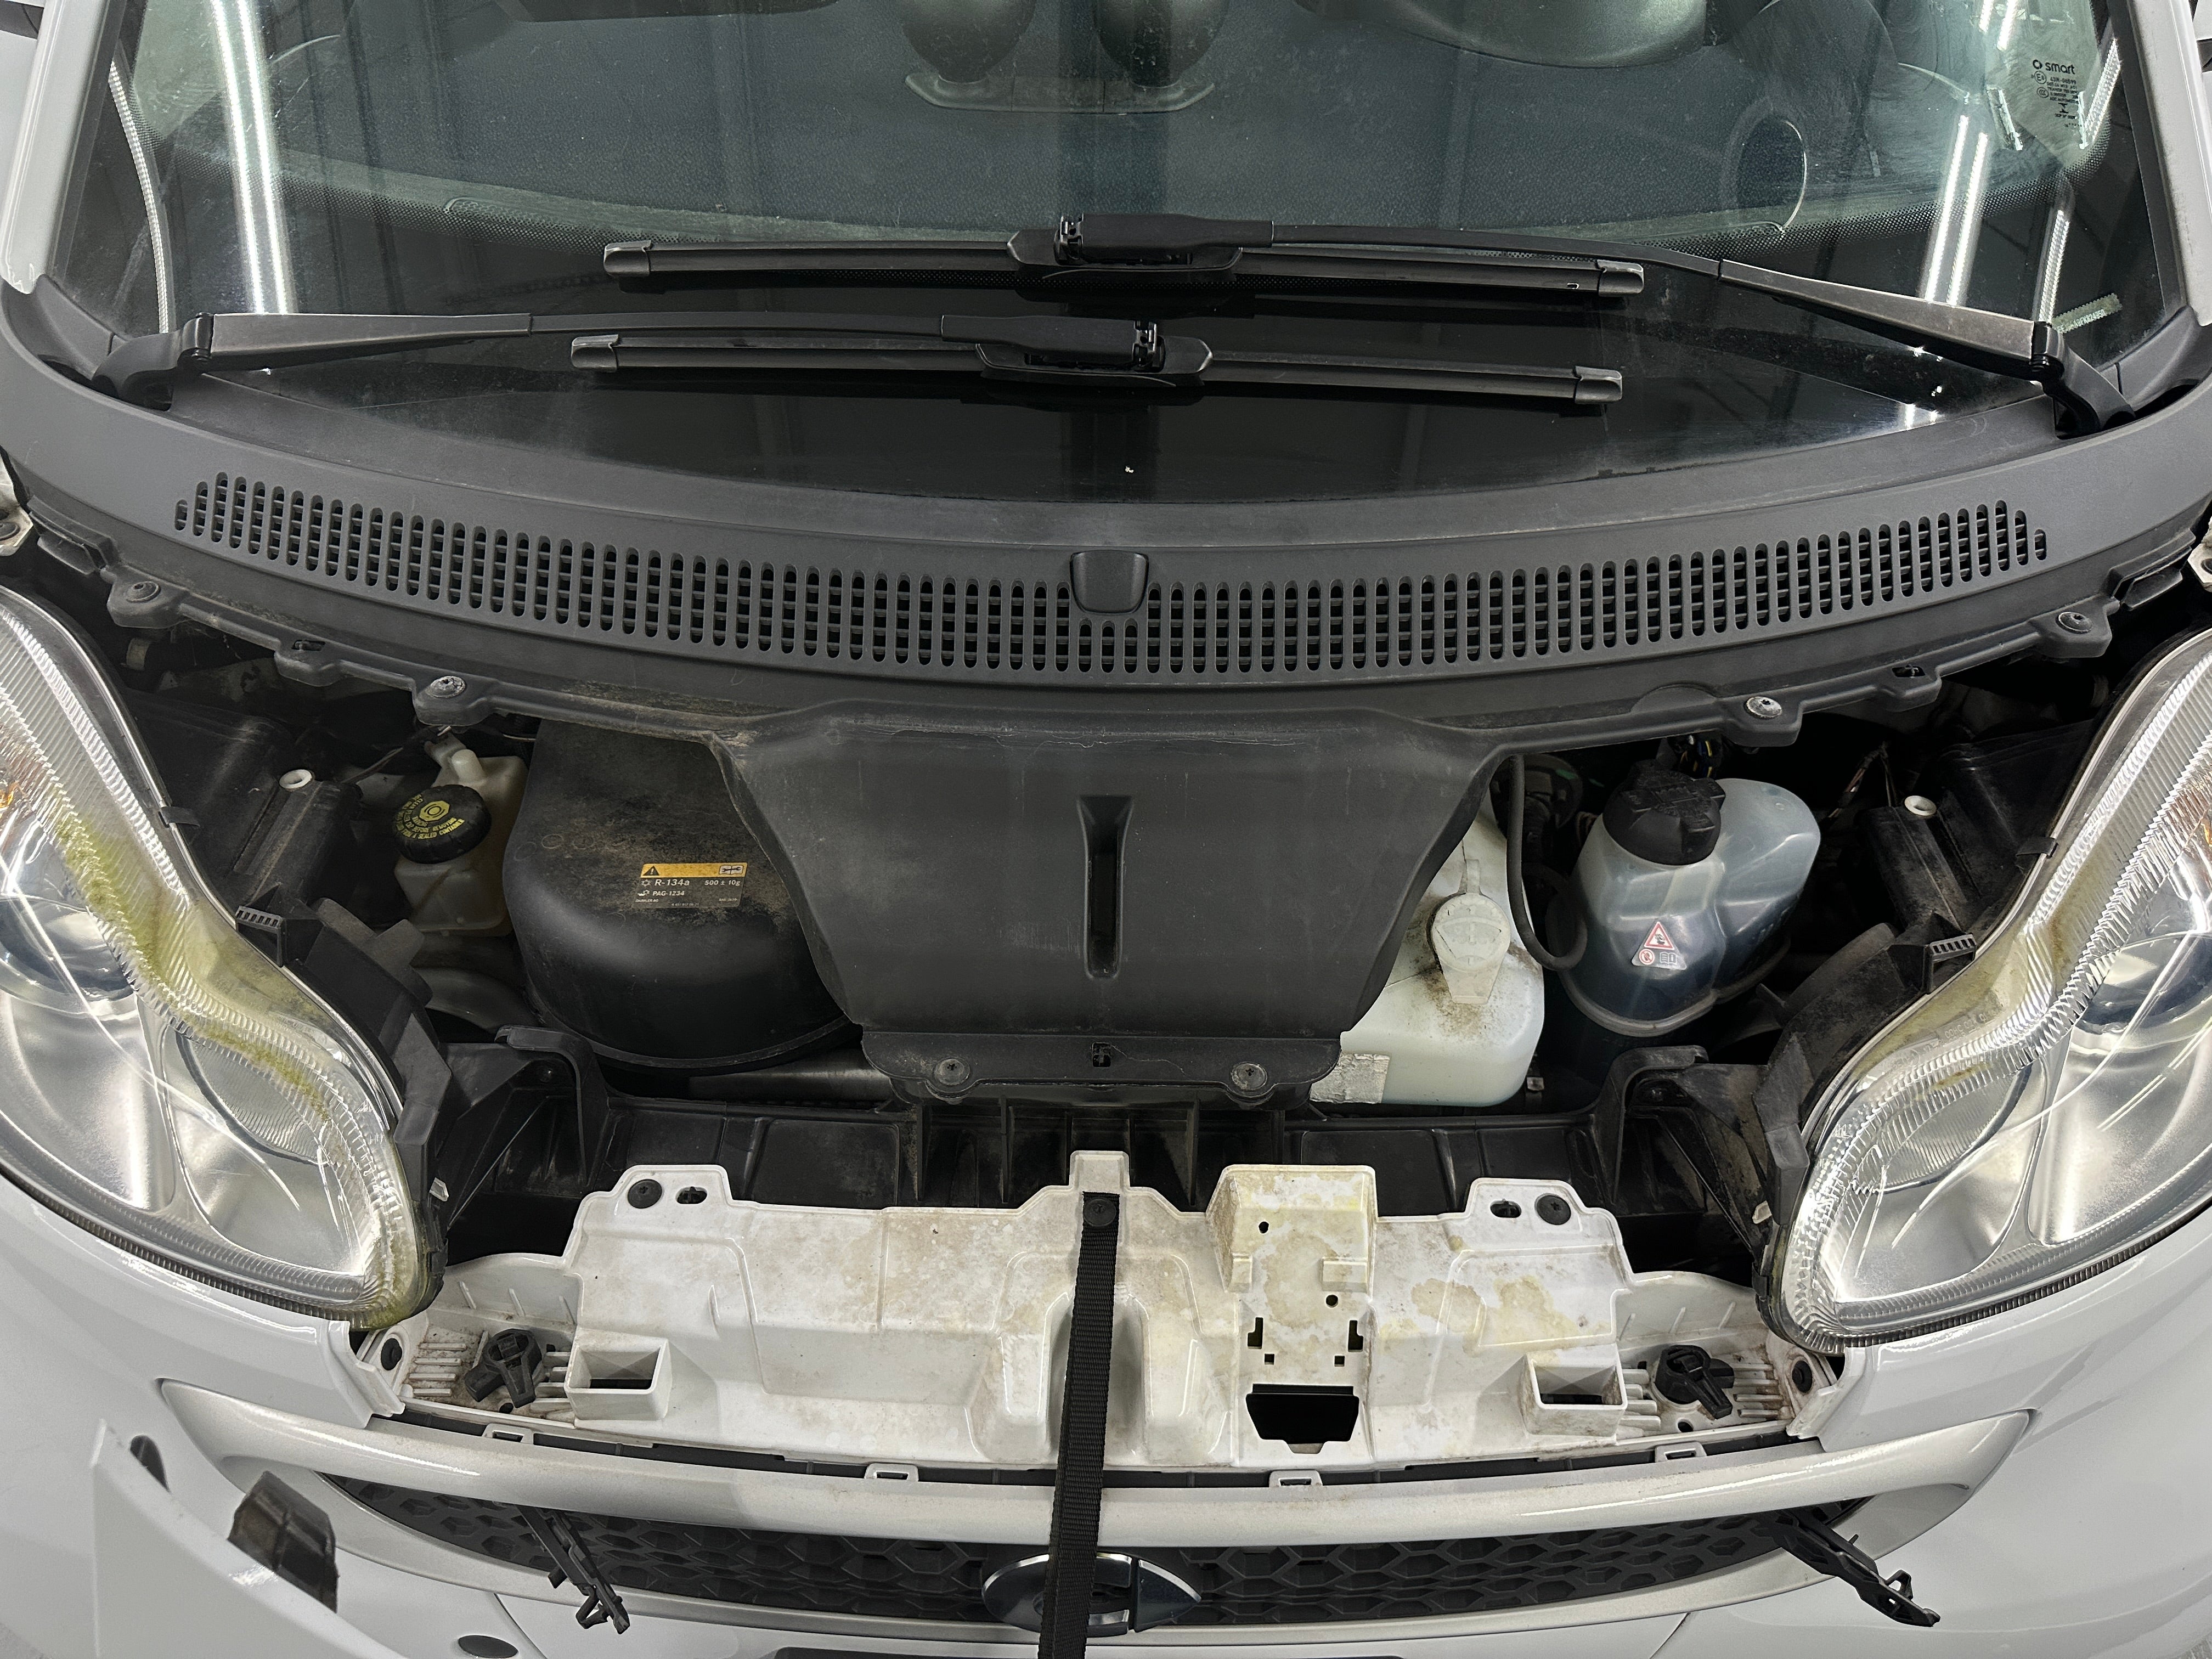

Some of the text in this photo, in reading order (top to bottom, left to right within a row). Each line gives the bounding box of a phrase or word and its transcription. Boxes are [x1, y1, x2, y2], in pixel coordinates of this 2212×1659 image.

[2045, 62, 2075, 75] smart
[409, 798, 423, 809] CLEAN
[432, 817, 457, 832] REMOVING
[439, 819, 465, 835] CONTAINER
